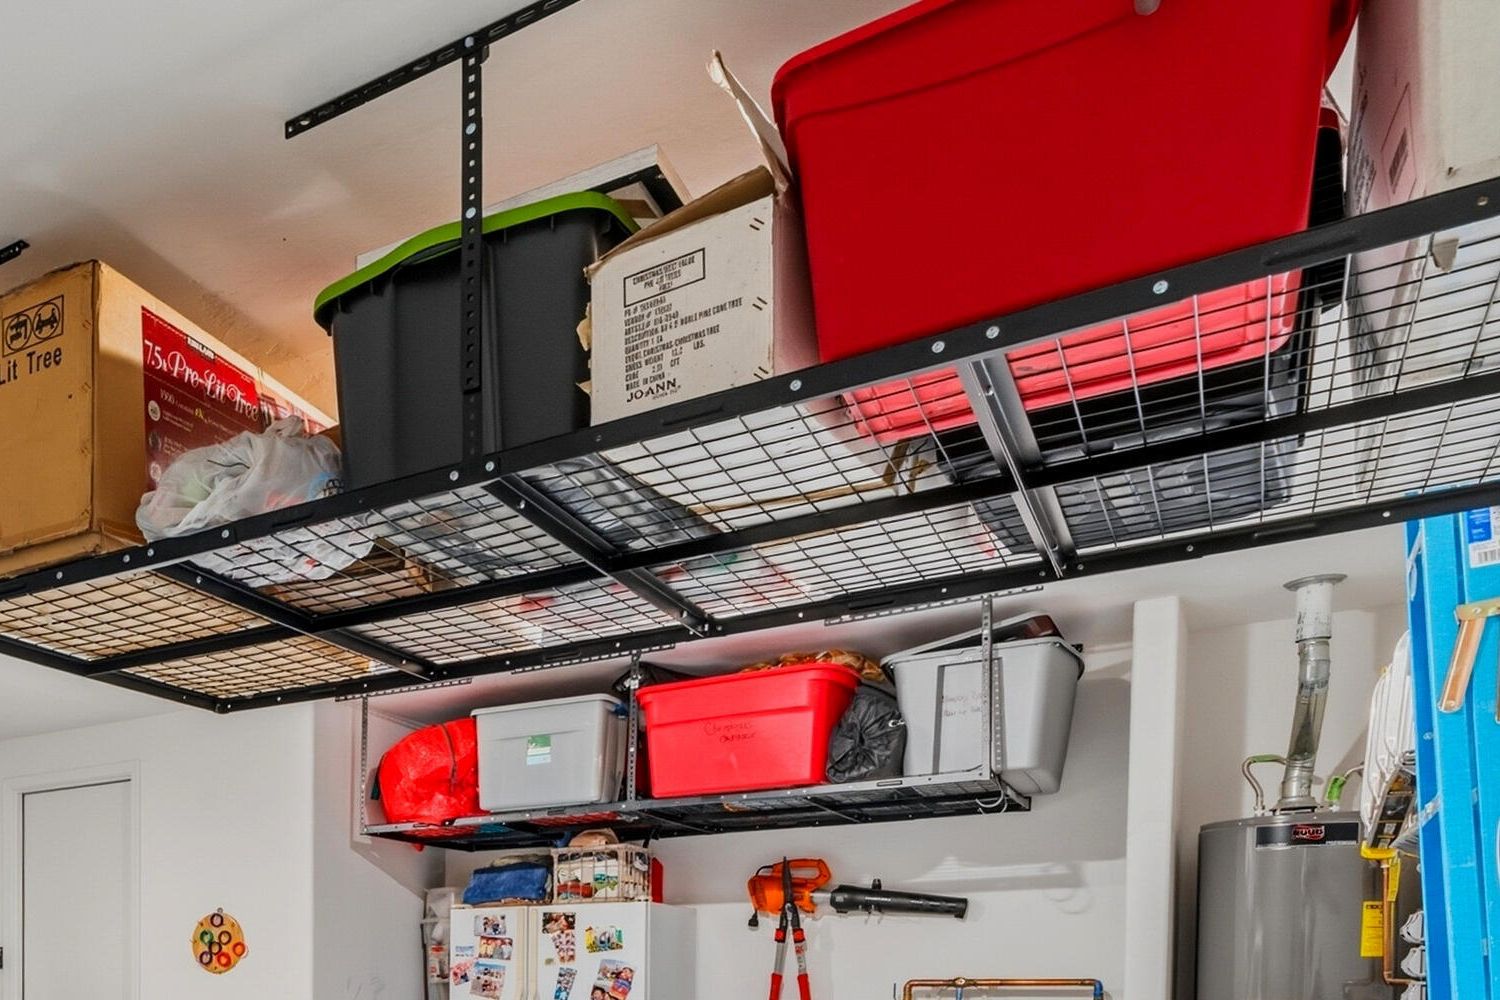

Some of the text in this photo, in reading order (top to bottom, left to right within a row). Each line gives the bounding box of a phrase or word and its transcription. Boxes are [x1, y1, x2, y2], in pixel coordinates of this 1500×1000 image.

[26, 347, 62, 375] Tree
[168, 350, 228, 402] Pre-Lit
[226, 382, 259, 422] Tree
[626, 377, 677, 403] JOANN
